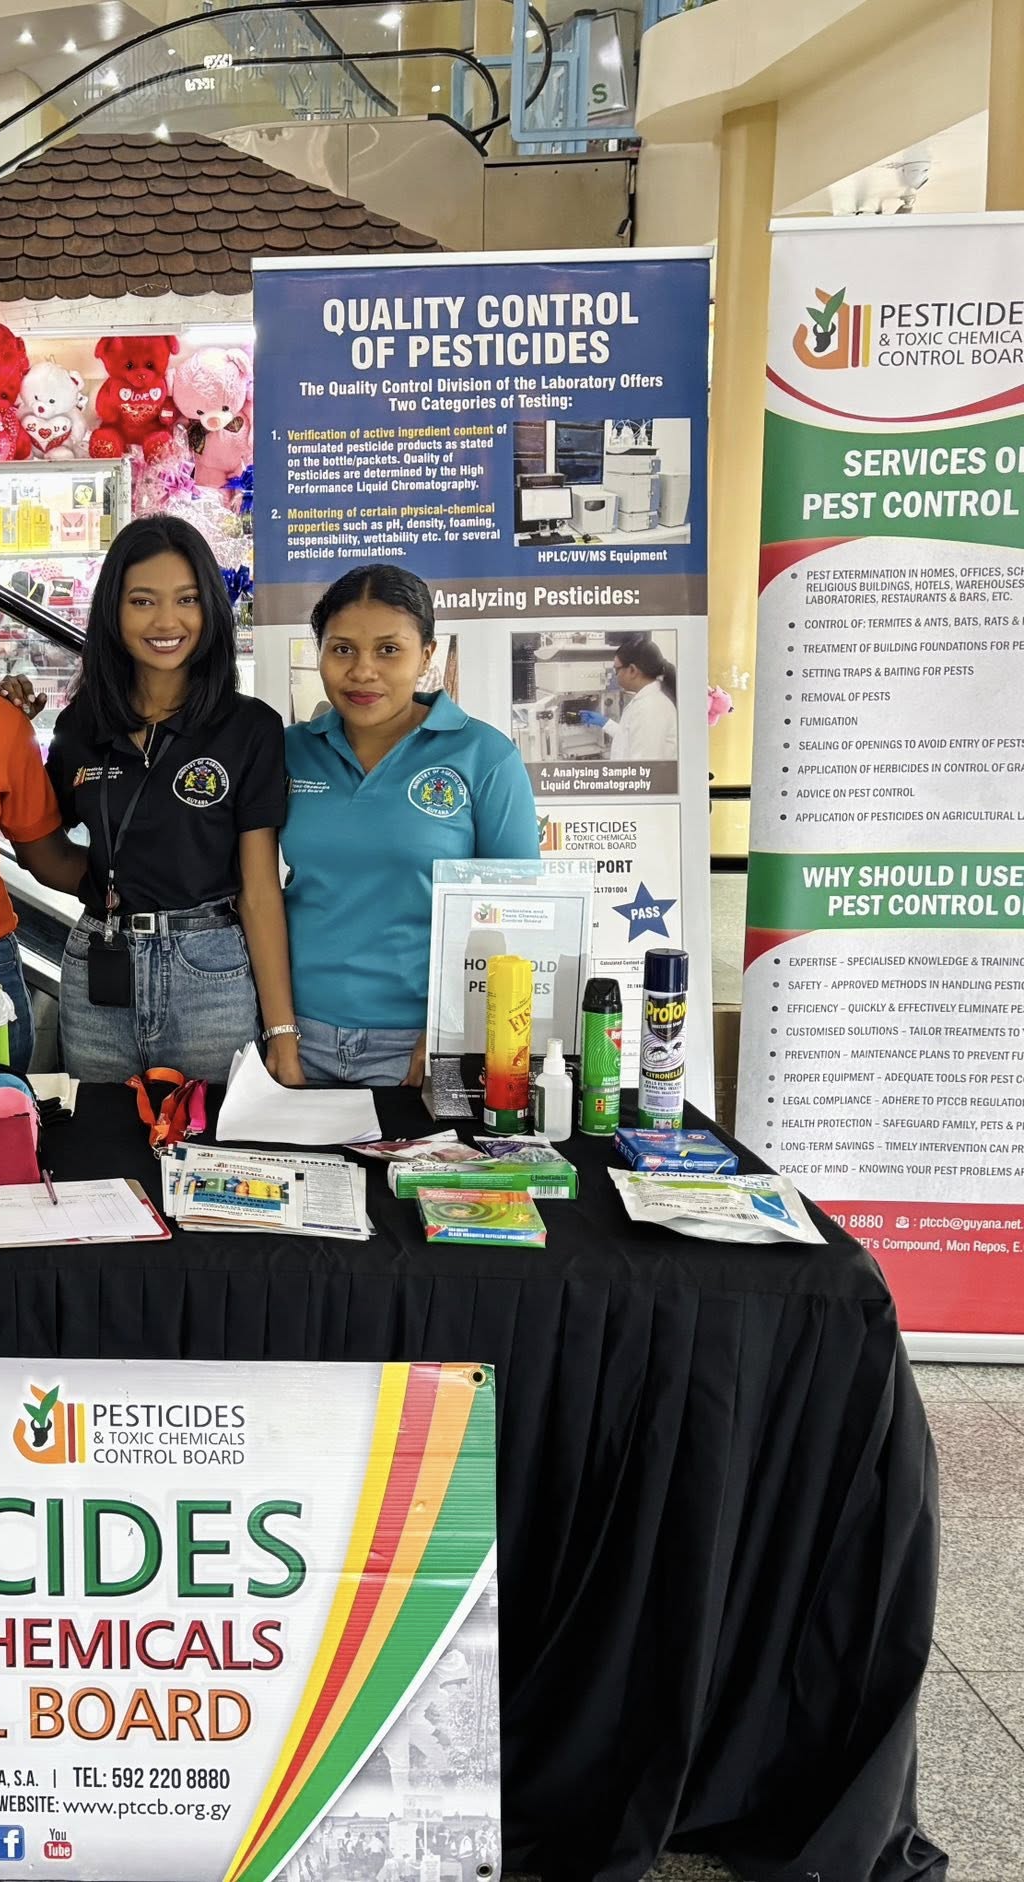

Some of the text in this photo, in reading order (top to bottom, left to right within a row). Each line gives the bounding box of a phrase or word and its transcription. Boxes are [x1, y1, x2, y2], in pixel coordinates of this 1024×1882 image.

[323, 292, 639, 335] QUALITY CONTROL
[880, 301, 1024, 327] PESTICIDE
[879, 333, 890, 347] &
[896, 332, 943, 346] TOXIC
[352, 331, 609, 369] OF PESTICIDES
[878, 350, 965, 366] CONTROL
[299, 374, 663, 397] The Quality Control Division of the Laboratory Offers
[389, 394, 573, 412] Two Categories of Testing:
[271, 424, 507, 440] 1. Verification of active ingredient content of
[287, 437, 493, 454] formulated pesticide products as stated
[843, 448, 987, 476] SERVICES
[803, 490, 1019, 519] PEST CONTROL
[538, 550, 667, 563] HPLC/UV/MS Equipment
[433, 586, 640, 611] Analyzing Pesticides:
[802, 666, 974, 678] SETTING TRAPS & BAITING FOR PESTS
[801, 691, 891, 702] REMOVAL OF PESTS
[800, 716, 858, 726] FUMIGATION
[540, 766, 651, 779] 4. Analysing Sample by
[541, 780, 651, 792] Liquid Chromatography
[565, 821, 637, 833] PESTICIDES
[597, 833, 637, 841] CHEMICALS
[565, 842, 637, 850] CONTROL BOARD
[802, 865, 1024, 888] WHY SHOULD I USE
[828, 895, 884, 916] PEST
[888, 894, 998, 915] CONTROL
[630, 906, 661, 921] PASS
[300, 1159, 350, 1168] NOTICE
[849, 1214, 884, 1228] 8880
[882, 1238, 944, 1253] Compound,
[947, 1240, 970, 1252] Mon
[974, 1240, 1009, 1254] Repos,
[93, 1404, 245, 1428] PESTICIDES
[93, 1431, 245, 1445] & TOXIC CHEMICALS
[93, 1449, 244, 1464] CONTROL BOARD
[29, 1686, 252, 1741] BOARD
[14, 1770, 39, 1787] S.A.
[73, 1767, 230, 1789] TEL: 592 220 8880
[63, 1799, 231, 1820] www.ptccb.org.gy
[49, 1828, 67, 1841] You
[46, 1843, 71, 1857] Tube
